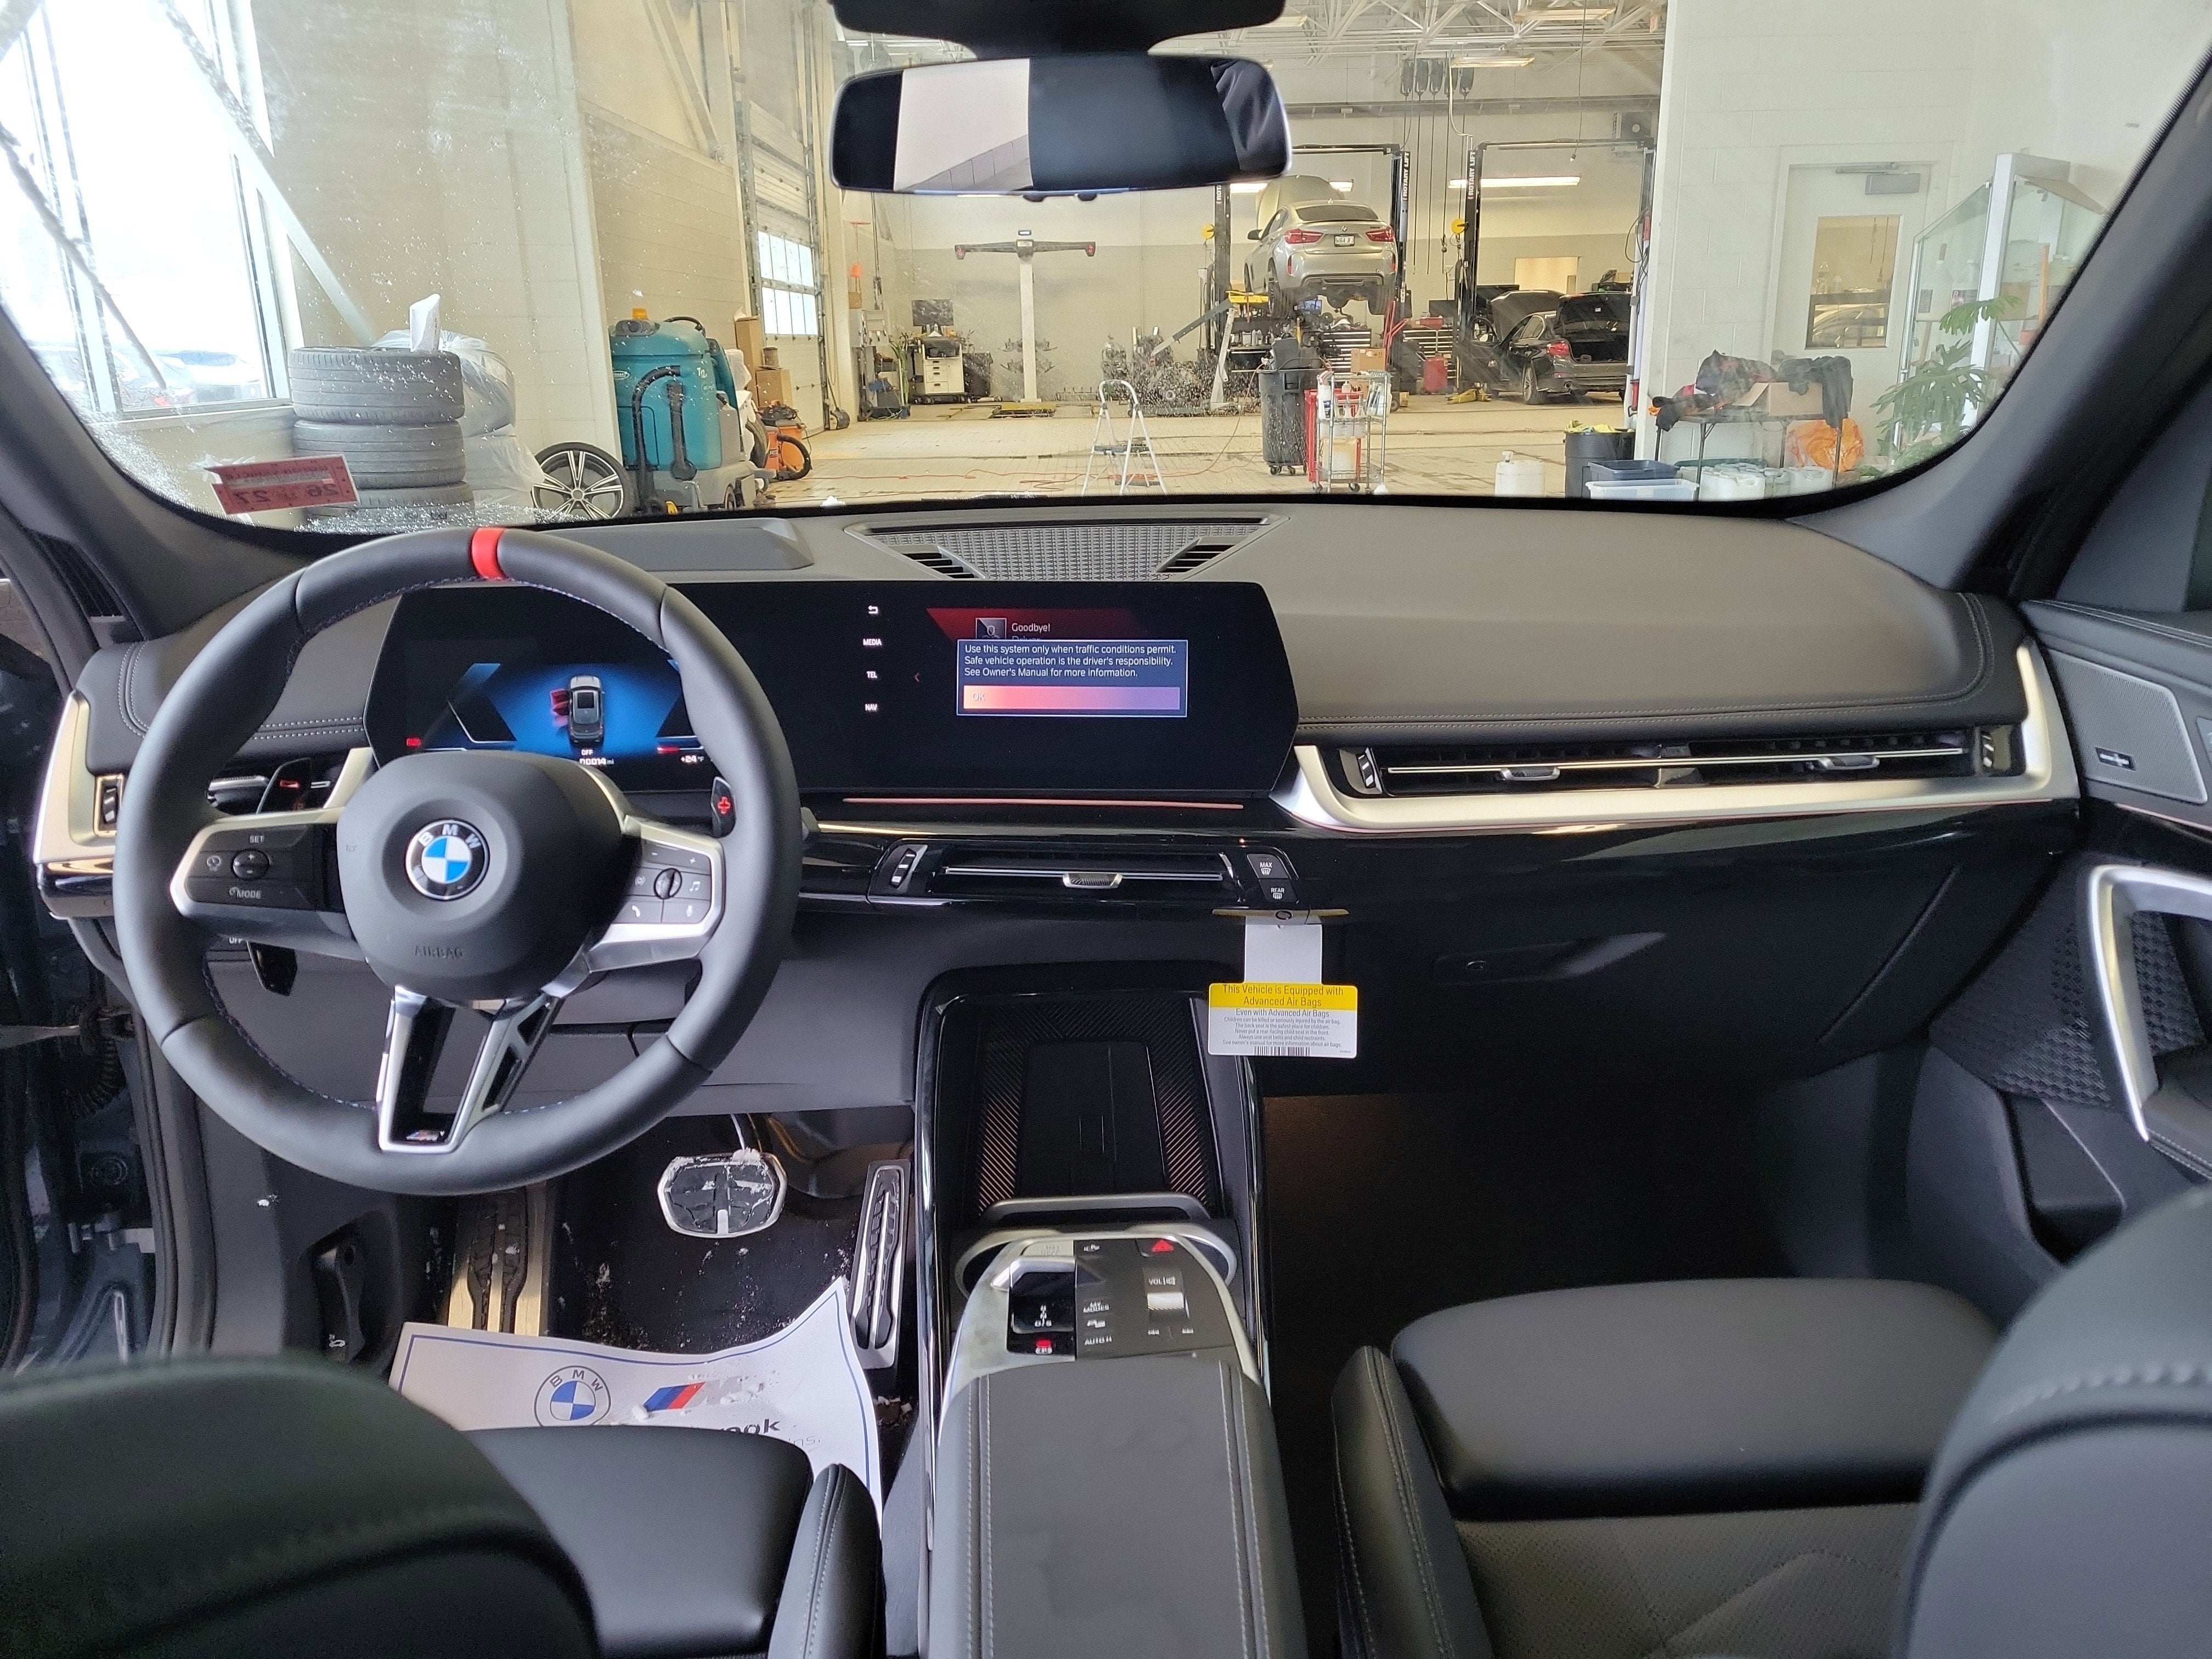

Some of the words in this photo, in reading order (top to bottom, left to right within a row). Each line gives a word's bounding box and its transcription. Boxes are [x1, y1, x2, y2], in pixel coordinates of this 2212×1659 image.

[1012, 623, 1051, 633] Goodbye!
[965, 645, 981, 653] Use
[983, 645, 998, 653] this
[1000, 645, 1030, 654] system
[1032, 645, 1049, 655] only
[1051, 645, 1073, 653] when
[1076, 645, 1099, 653] traffic
[1101, 645, 1144, 653] conditions
[1147, 645, 1176, 655] permit.
[964, 656, 983, 665] Safe
[985, 656, 1014, 665] vehicle
[1016, 656, 1056, 667] operation
[1058, 657, 1065, 665] is
[1068, 657, 1080, 665] the
[1083, 657, 1113, 665] driver's
[1115, 657, 1173, 667] responsibility.
[964, 668, 980, 676] See
[983, 668, 1015, 676] Owner's
[1018, 668, 1048, 676] Manual
[1051, 668, 1062, 676] for
[1088, 668, 1138, 677] information.
[972, 692, 985, 701] OK
[417, 823, 482, 849] BMW
[236, 890, 262, 899] MODE
[1223, 984, 1240, 994] This
[1242, 984, 1273, 994] Vehicle
[1275, 985, 1282, 994] is
[1284, 985, 1323, 996] Equipped
[1326, 986, 1343, 995] with
[1243, 996, 1284, 1006] Advanced
[1286, 997, 1298, 1006] Air
[1301, 997, 1322, 1008] Bags
[1313, 1010, 1329, 1018] Bags
[550, 1369, 603, 1391] BMW
